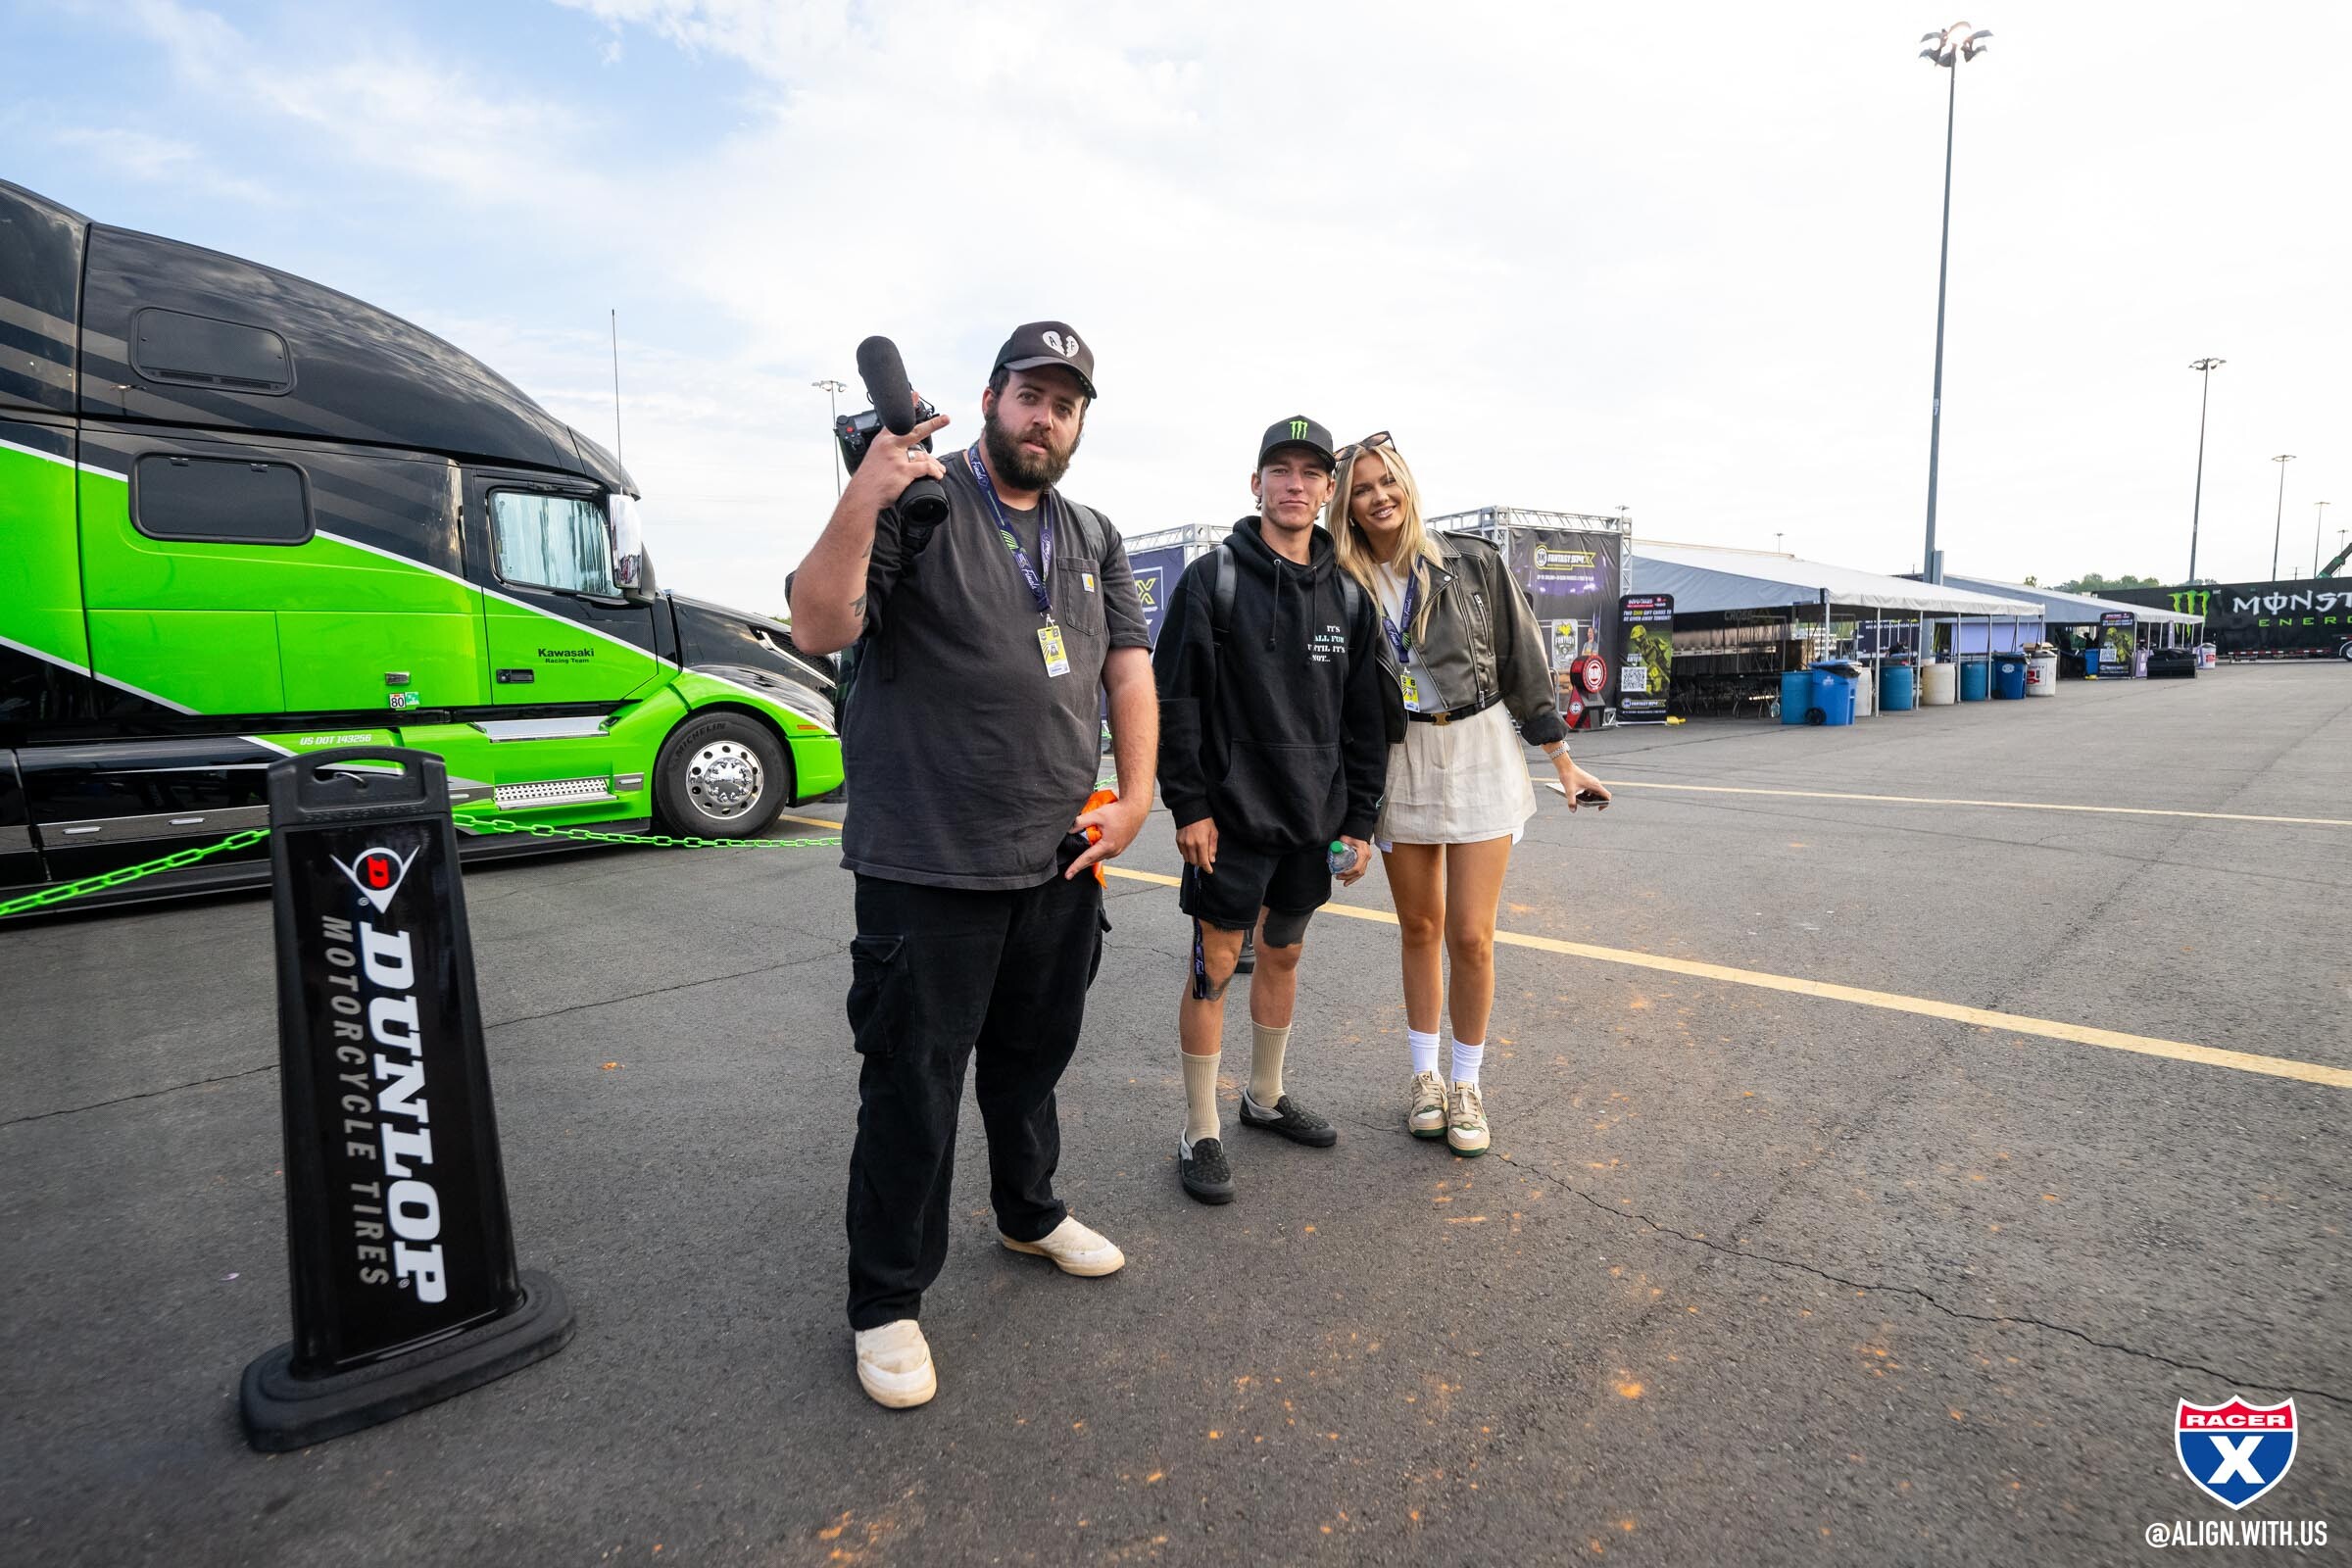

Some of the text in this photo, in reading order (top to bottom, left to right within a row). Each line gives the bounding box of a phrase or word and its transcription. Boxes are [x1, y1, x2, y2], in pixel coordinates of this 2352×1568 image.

[1049, 335, 1075, 351] A F
[538, 648, 595, 658] Kawasaki
[391, 697, 405, 708] 80
[300, 734, 372, 746] US DOT 143256
[675, 722, 726, 758] MICHELIN
[320, 914, 390, 1286] MOTORCYCLE TIRES
[358, 920, 448, 1303] DUNLOP
